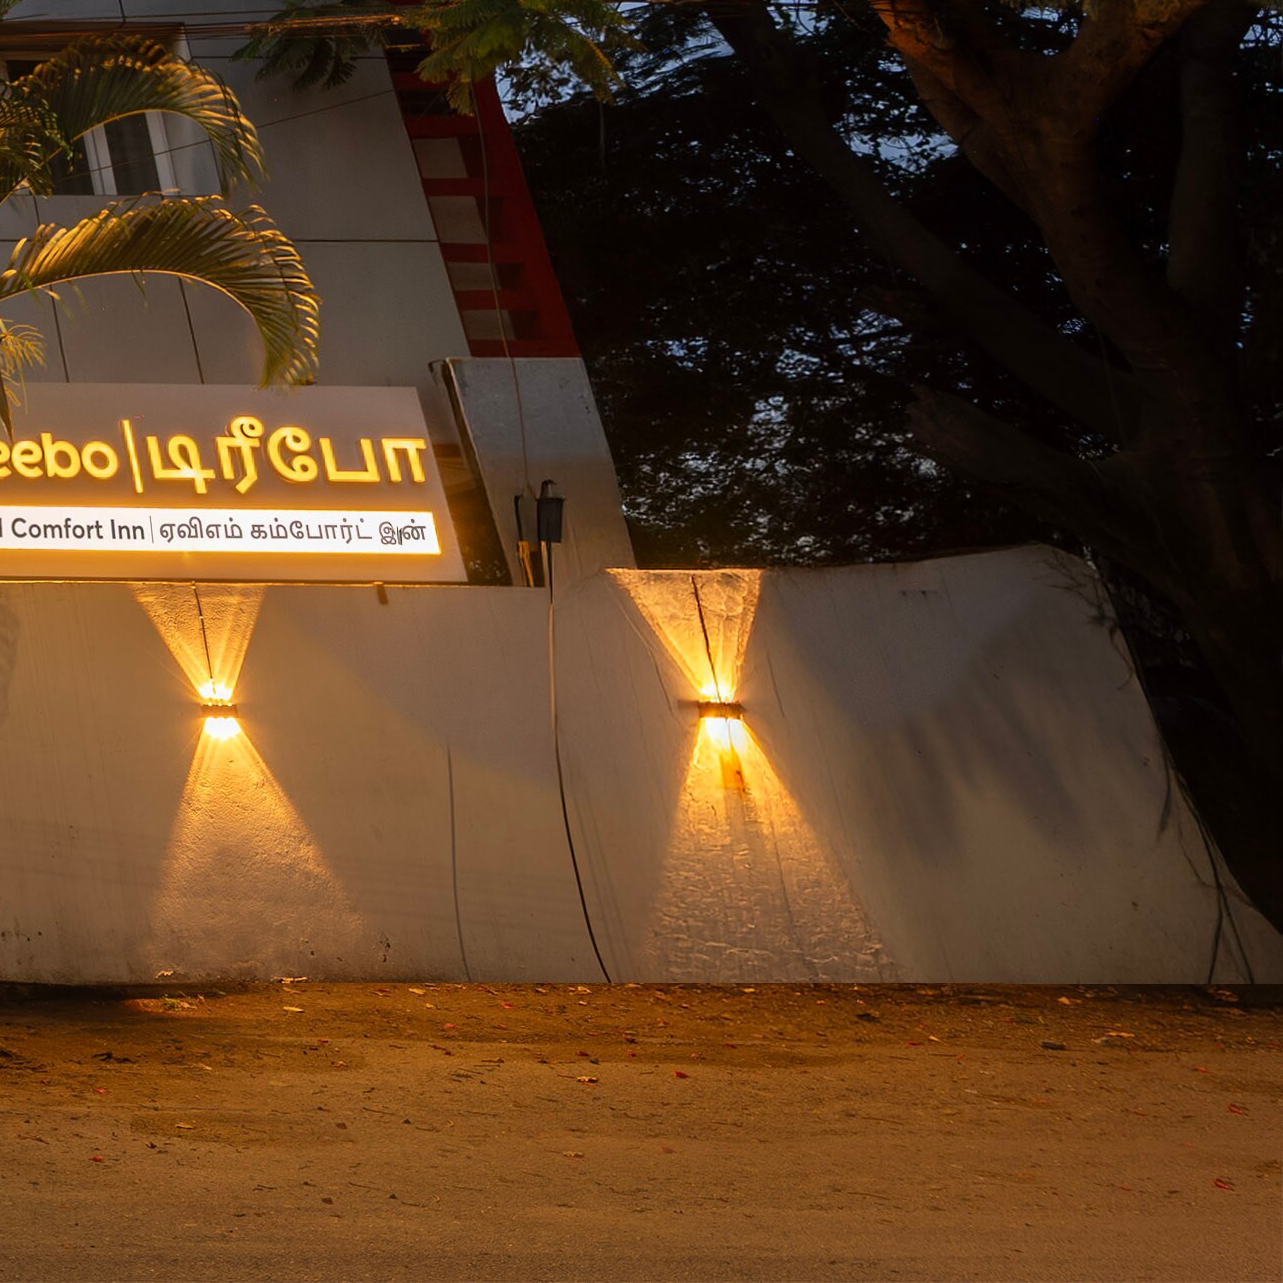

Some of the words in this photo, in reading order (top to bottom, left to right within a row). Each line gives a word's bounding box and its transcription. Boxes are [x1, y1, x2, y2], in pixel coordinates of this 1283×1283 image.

[145, 416, 427, 494] டிரீபோ
[10, 517, 104, 540] Comfort
[110, 519, 146, 540] Inn
[159, 516, 243, 543] ஏவிஎம்
[250, 517, 373, 544] கம்போர்ட்
